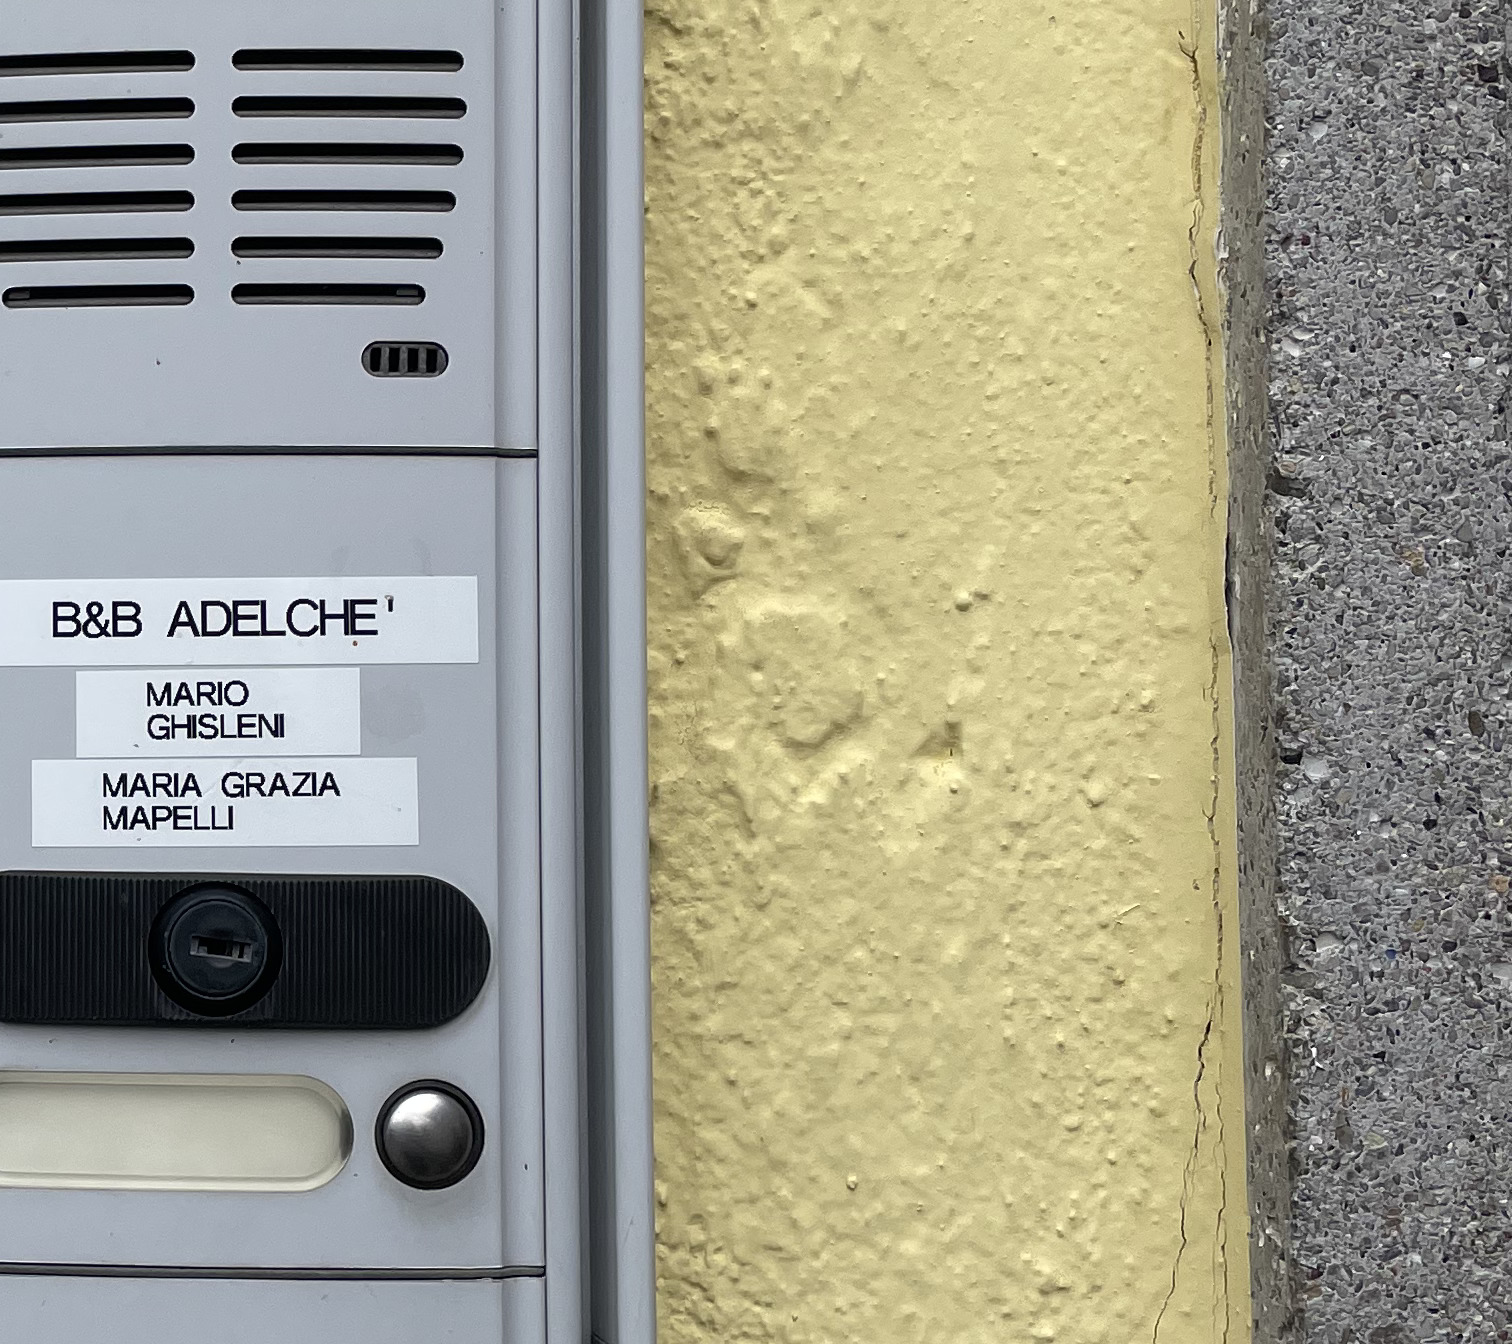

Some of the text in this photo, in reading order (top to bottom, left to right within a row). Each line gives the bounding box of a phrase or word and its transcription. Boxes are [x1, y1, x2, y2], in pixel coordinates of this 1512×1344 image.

[51, 596, 395, 640] B&B ADELCHE'
[145, 679, 251, 708] MARIO
[146, 712, 286, 742] GHISLENI
[101, 770, 342, 800] MARIA GRAZIA
[102, 804, 235, 832] MAPELLI
